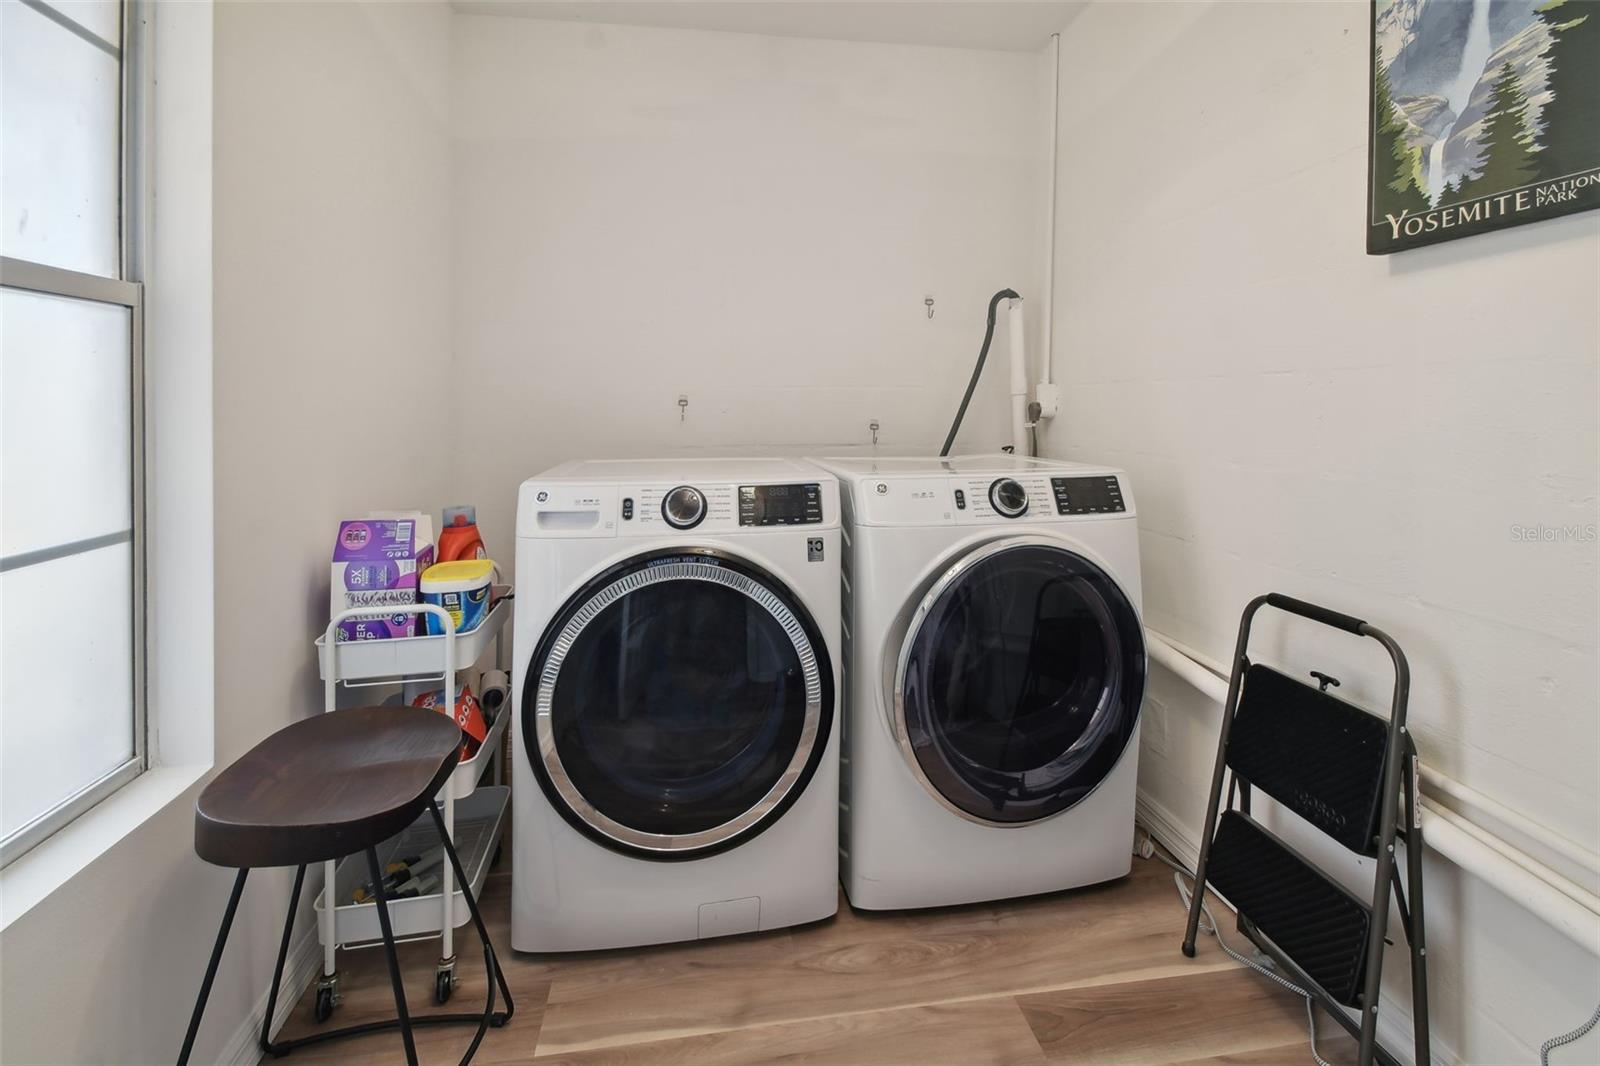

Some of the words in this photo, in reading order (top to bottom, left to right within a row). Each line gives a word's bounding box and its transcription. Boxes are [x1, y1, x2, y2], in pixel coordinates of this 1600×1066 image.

[1536, 188, 1578, 207] PARK
[1385, 190, 1531, 240] YOSEMITE
[351, 568, 362, 585] 5X
